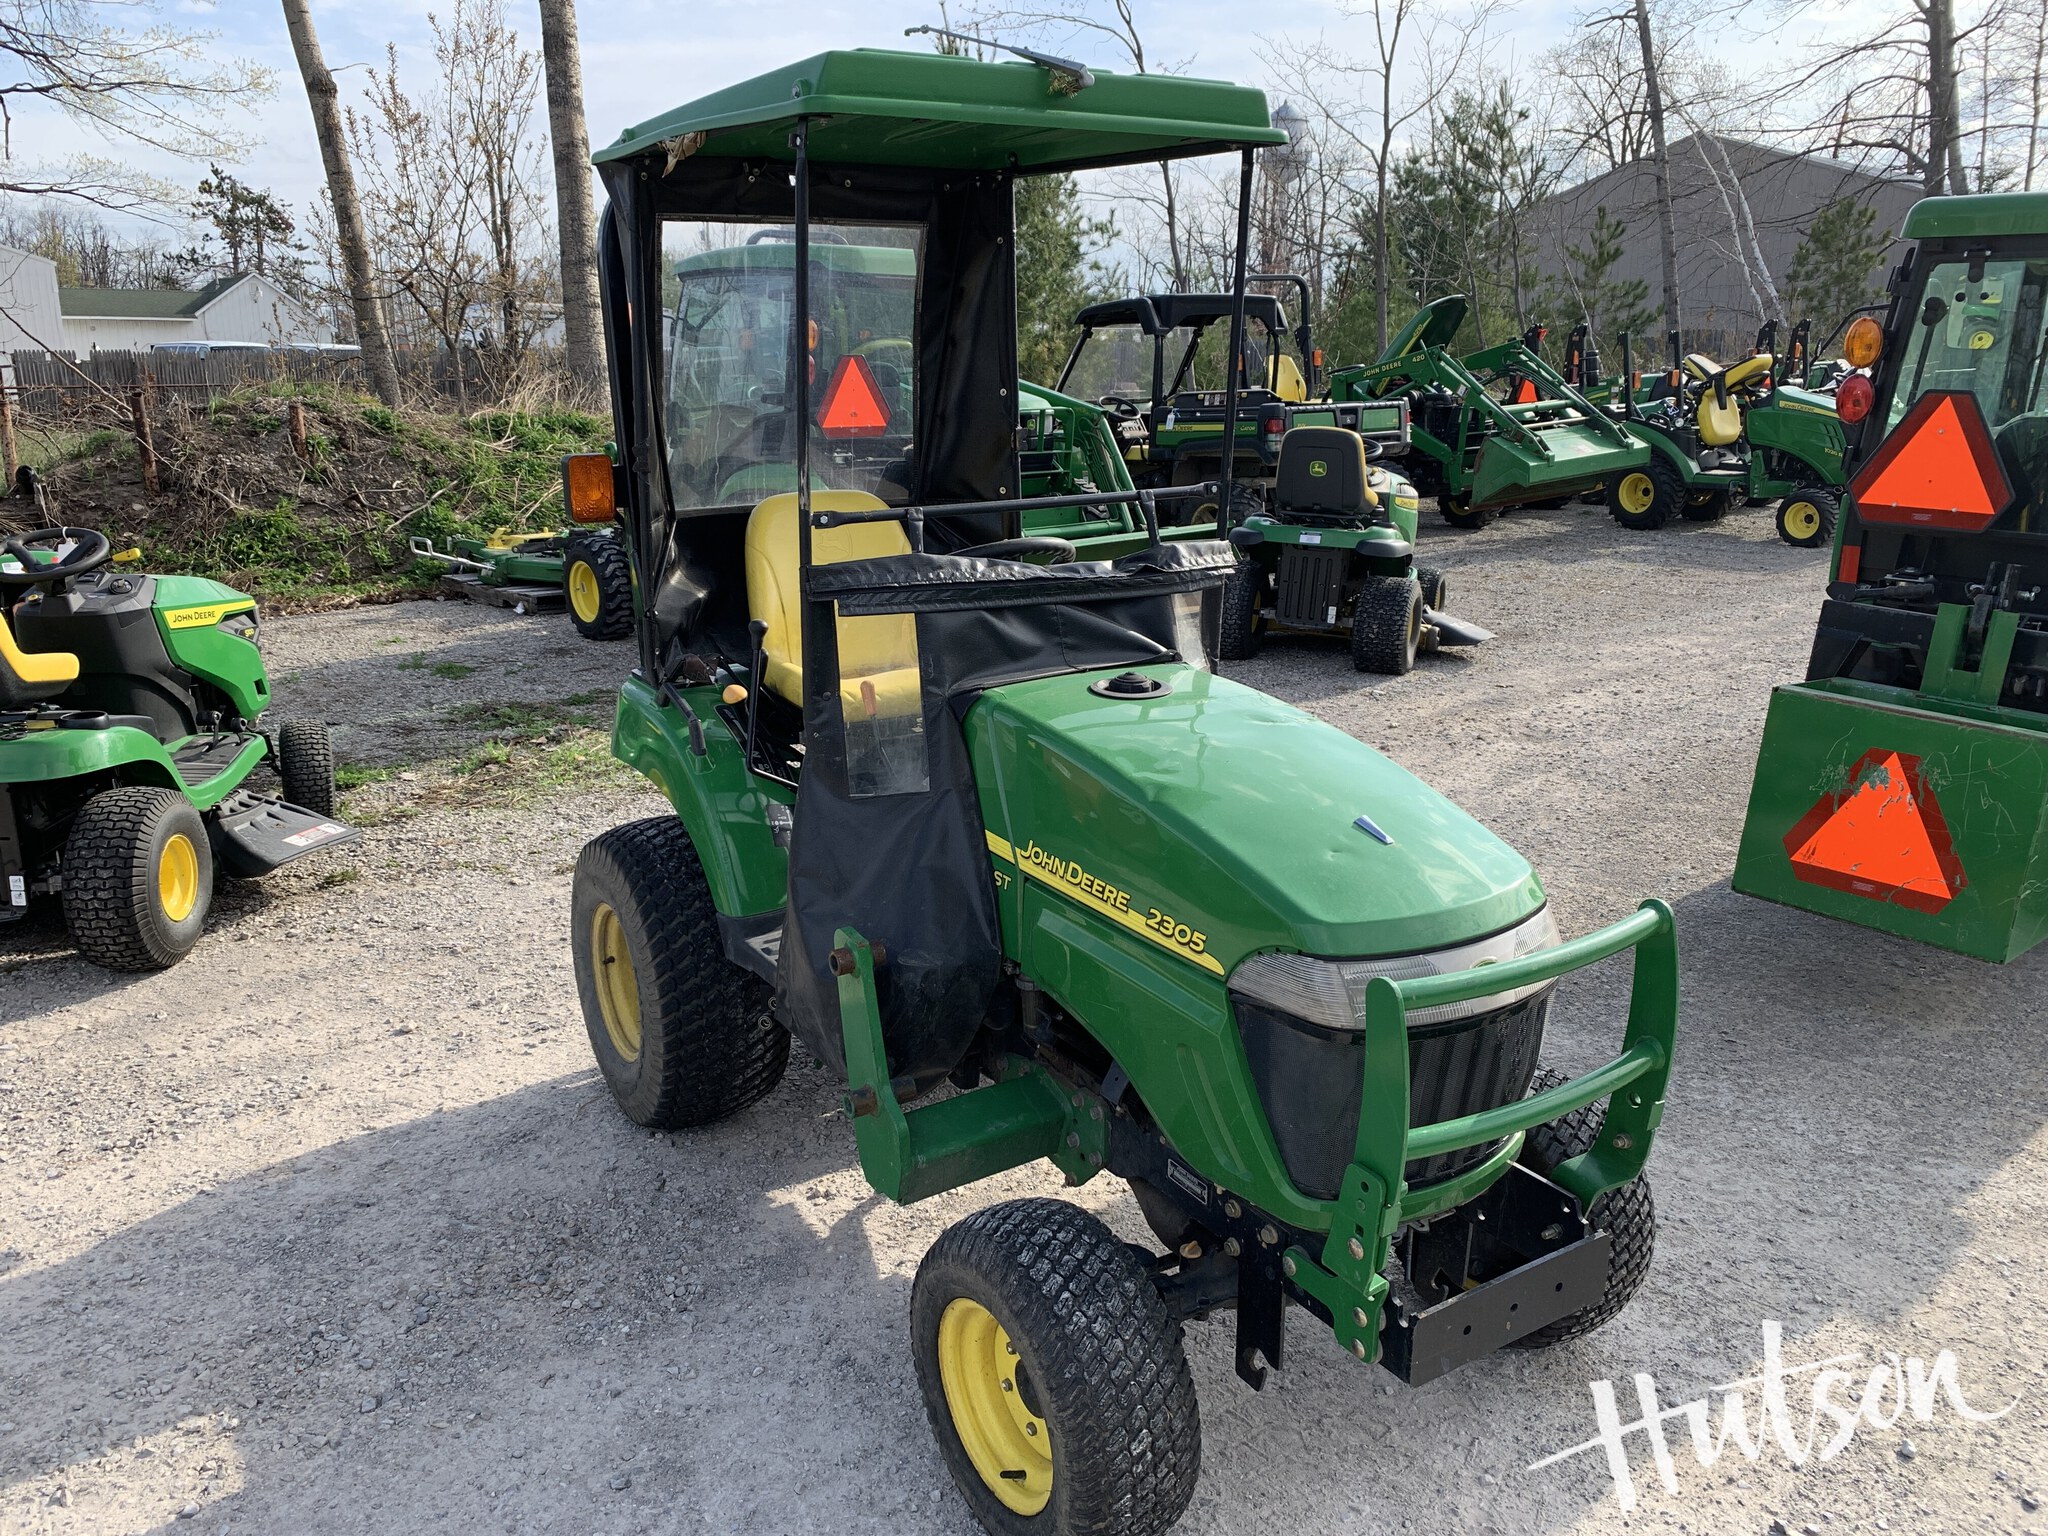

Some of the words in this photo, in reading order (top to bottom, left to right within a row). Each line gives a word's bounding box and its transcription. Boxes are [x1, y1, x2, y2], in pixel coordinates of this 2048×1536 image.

[1363, 366, 1380, 378] JOHN
[1381, 360, 1402, 372] DEERE
[1412, 354, 1425, 363] 420
[173, 613, 193, 623] JOHN
[194, 610, 216, 620] DEERE
[1020, 839, 1067, 879] JOHN
[1066, 860, 1131, 913] DEERE
[1145, 907, 1208, 954] 2305
